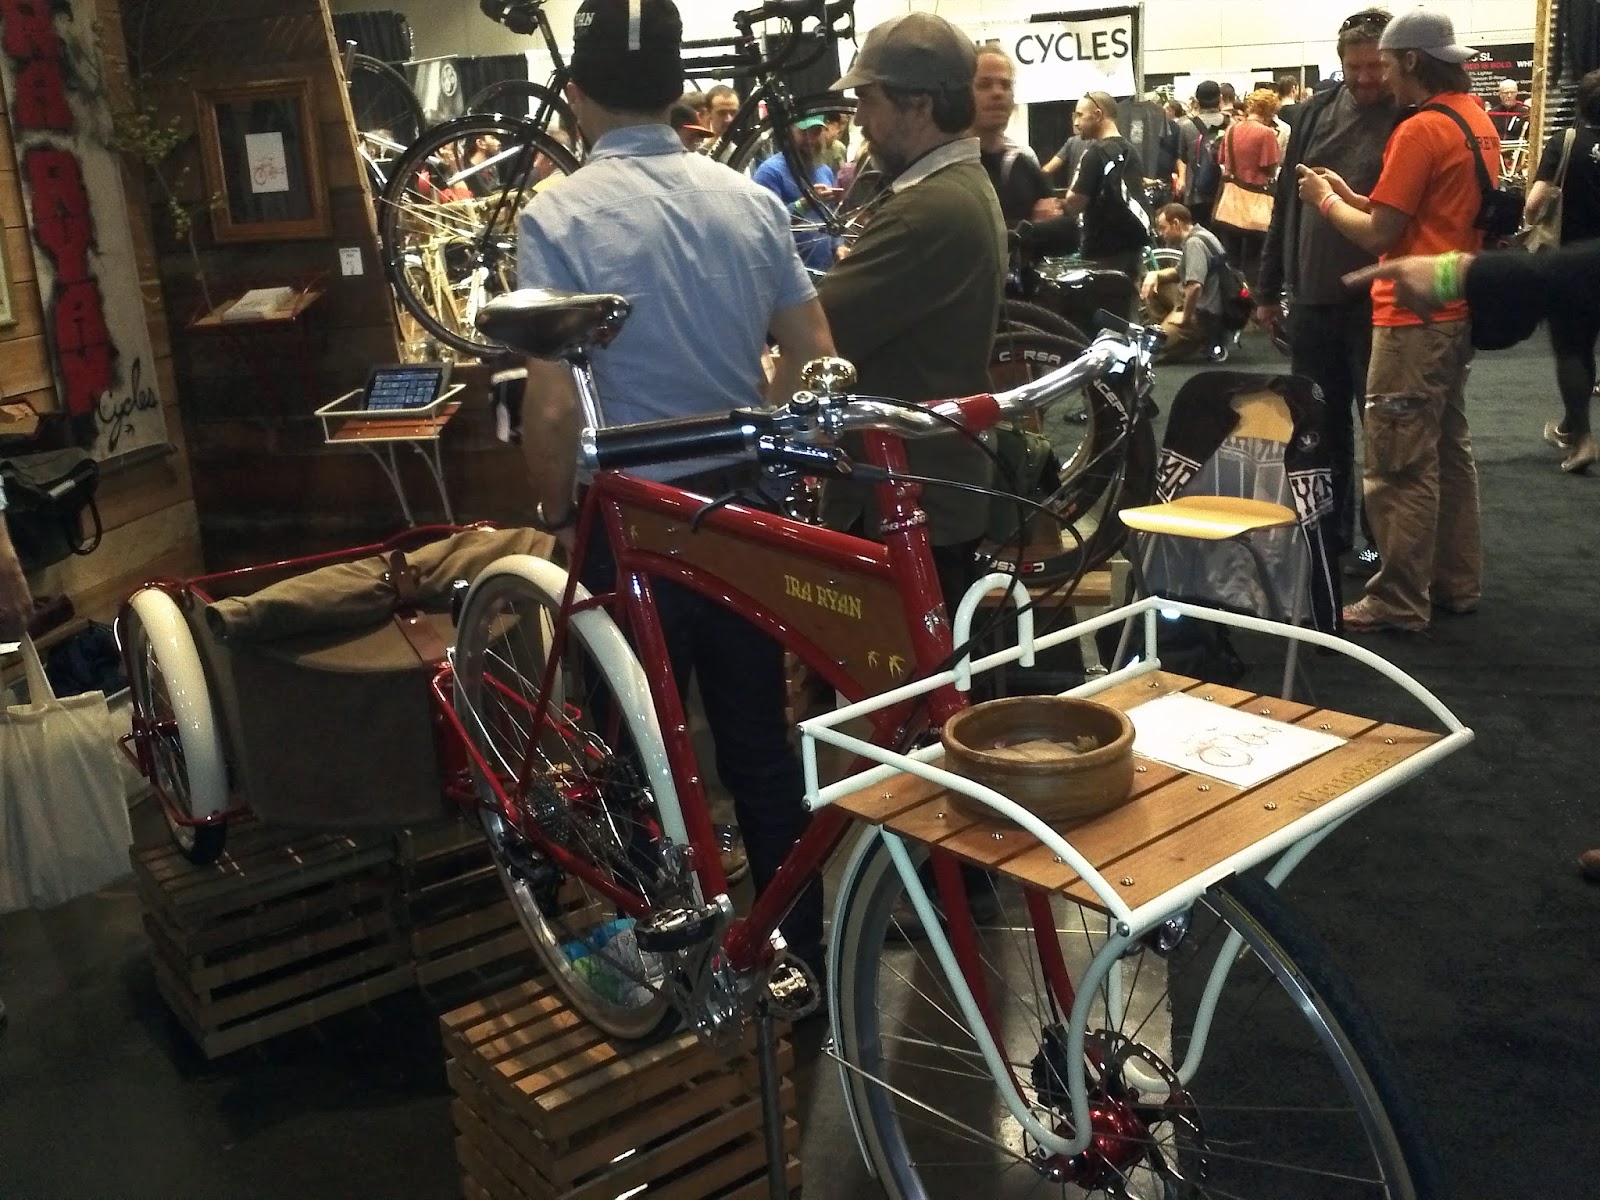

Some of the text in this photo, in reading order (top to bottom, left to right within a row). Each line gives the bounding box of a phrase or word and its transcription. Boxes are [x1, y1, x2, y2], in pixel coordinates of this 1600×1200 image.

[1015, 28, 1129, 65] CYCLES
[98, 358, 158, 453] Cycles
[784, 574, 862, 620] IRA RYAN
